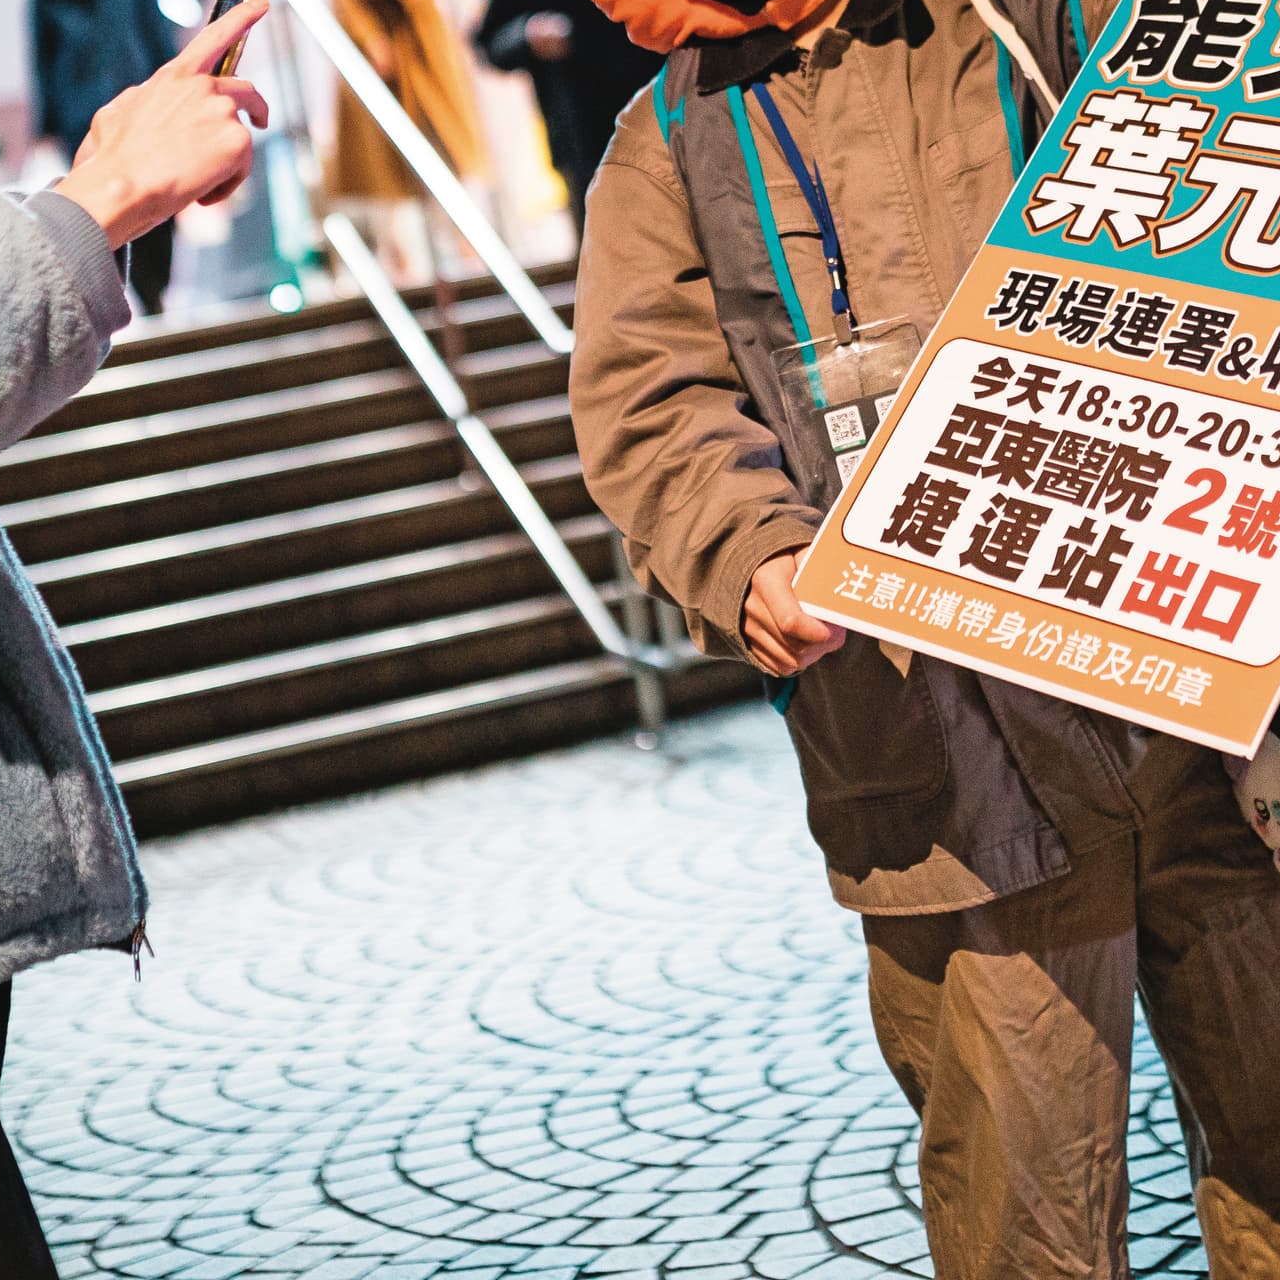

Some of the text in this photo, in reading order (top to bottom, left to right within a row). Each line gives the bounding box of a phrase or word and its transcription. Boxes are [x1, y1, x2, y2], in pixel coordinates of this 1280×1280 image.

[923, 403, 1172, 522] 亞東醫院
[880, 472, 1262, 644] 捷運站 出口
[833, 560, 1214, 708] 注意!!攜帶身份證及印章
